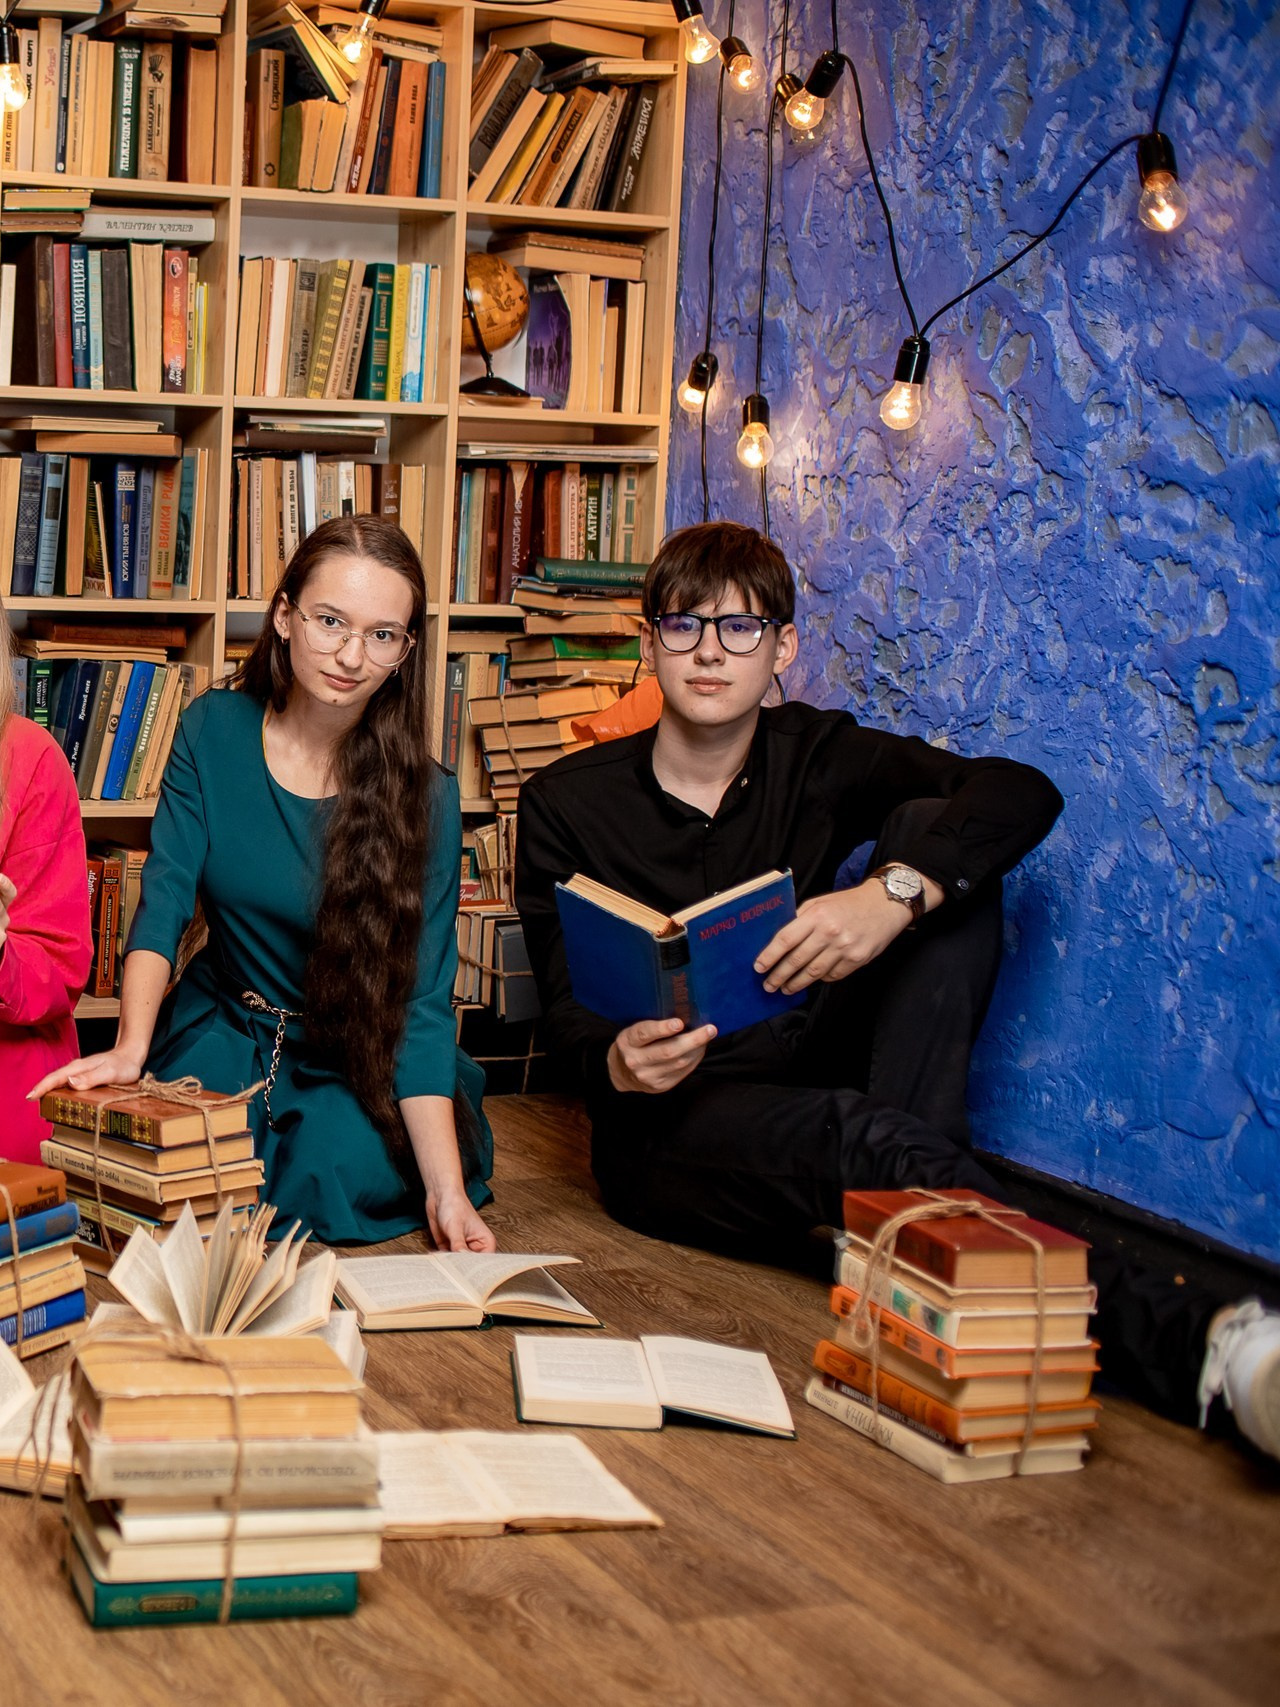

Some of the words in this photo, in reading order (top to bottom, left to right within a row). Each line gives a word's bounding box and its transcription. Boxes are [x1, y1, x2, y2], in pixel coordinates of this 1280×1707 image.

[122, 62, 135, 106] КВЕБЕКЕ
[4, 140, 14, 164] ЯВКА
[119, 116, 132, 171] АНЖЕЛИКА
[105, 220, 156, 232] ВАЛЕНТИН
[159, 222, 194, 234] КАТАЕВ
[72, 258, 87, 324] ПОЗИЦИЯ
[298, 328, 310, 381] ДРАЙЗЕР
[158, 505, 171, 548] ВЕЛИКА
[587, 496, 598, 540] КАТРИН
[122, 523, 130, 559] ТЫНЯНОВ
[511, 516, 522, 568] АНАТОЛИЙ
[122, 559, 130, 582] ЮРИЙ
[137, 691, 160, 753] ЧИНГИСХАН
[698, 917, 737, 941] МАРКО
[739, 895, 785, 924] ВОВЧОК
[840, 1383, 875, 1408] ЕХАНИКИ
